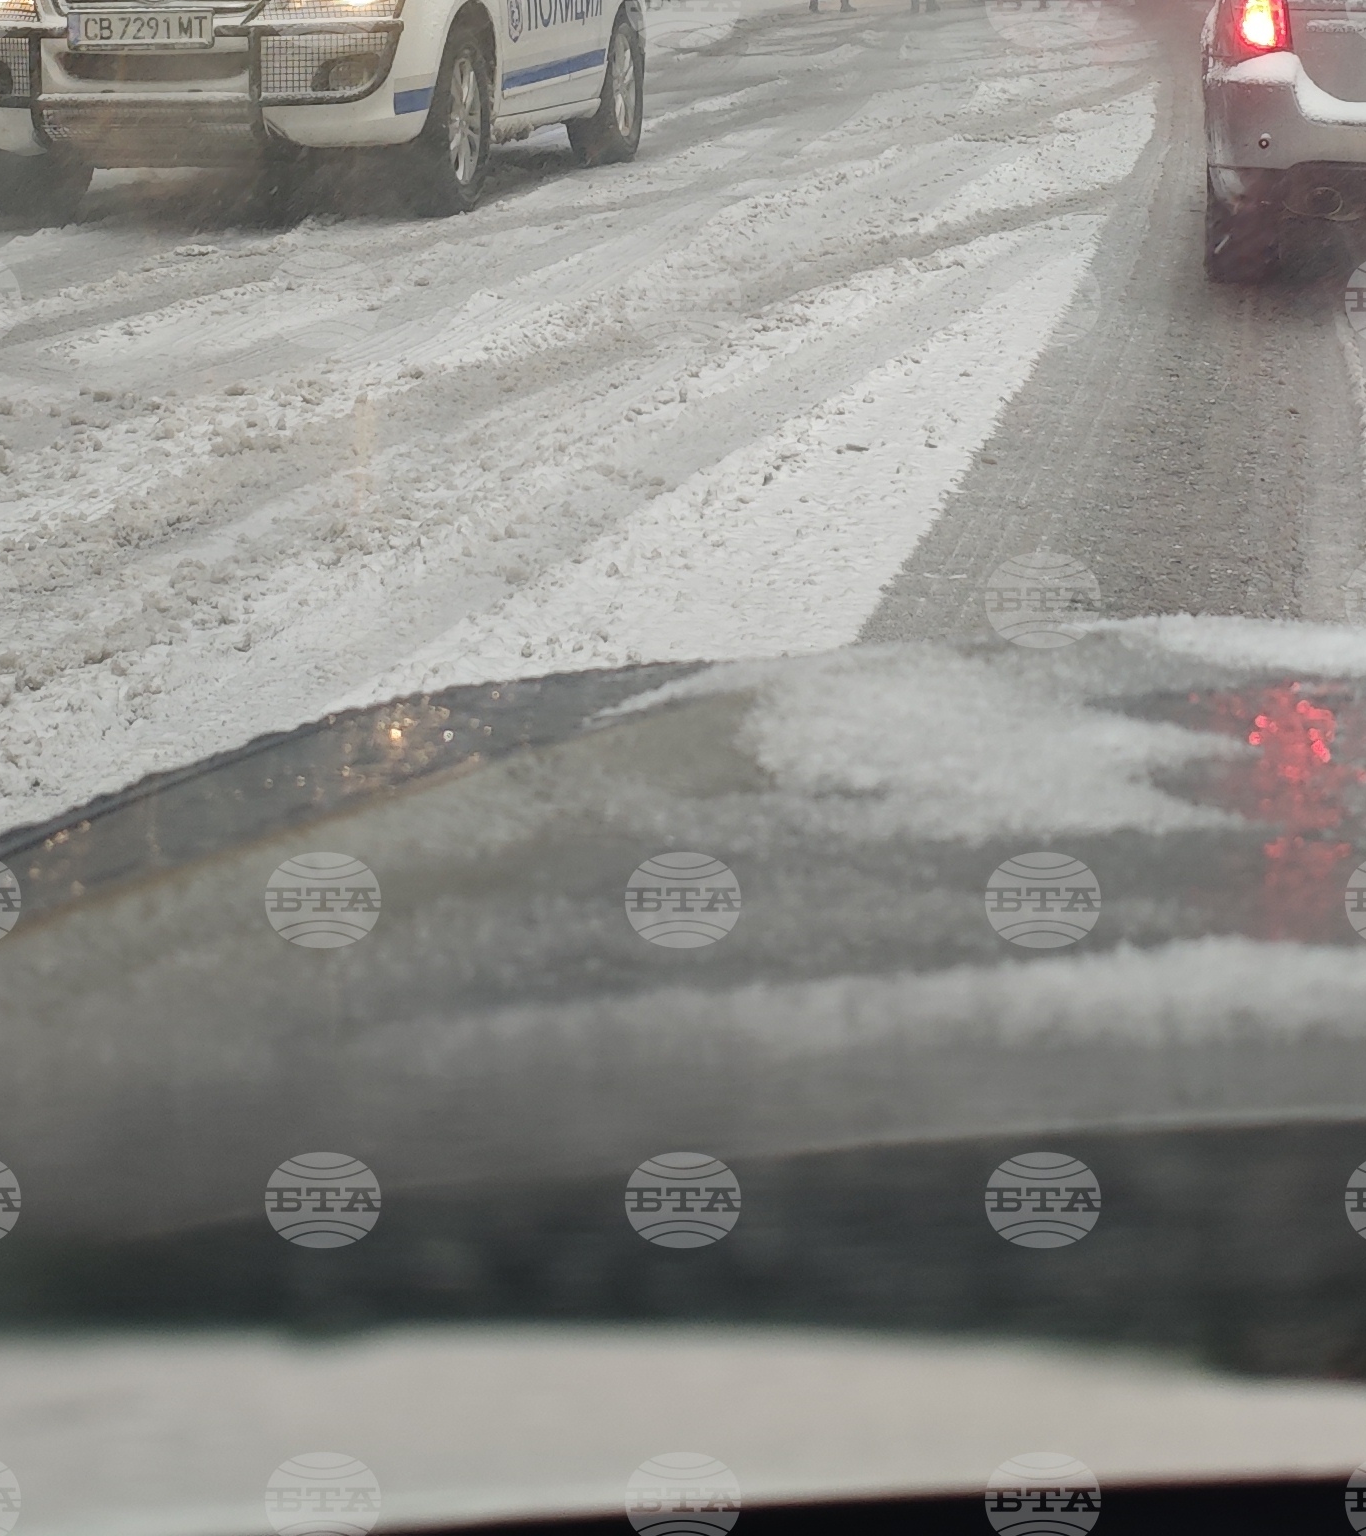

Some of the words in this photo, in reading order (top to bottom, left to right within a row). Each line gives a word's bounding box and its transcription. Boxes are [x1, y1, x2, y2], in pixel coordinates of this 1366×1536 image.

[84, 17, 113, 40] CB
[118, 17, 172, 40] 7291
[178, 15, 208, 39] MT
